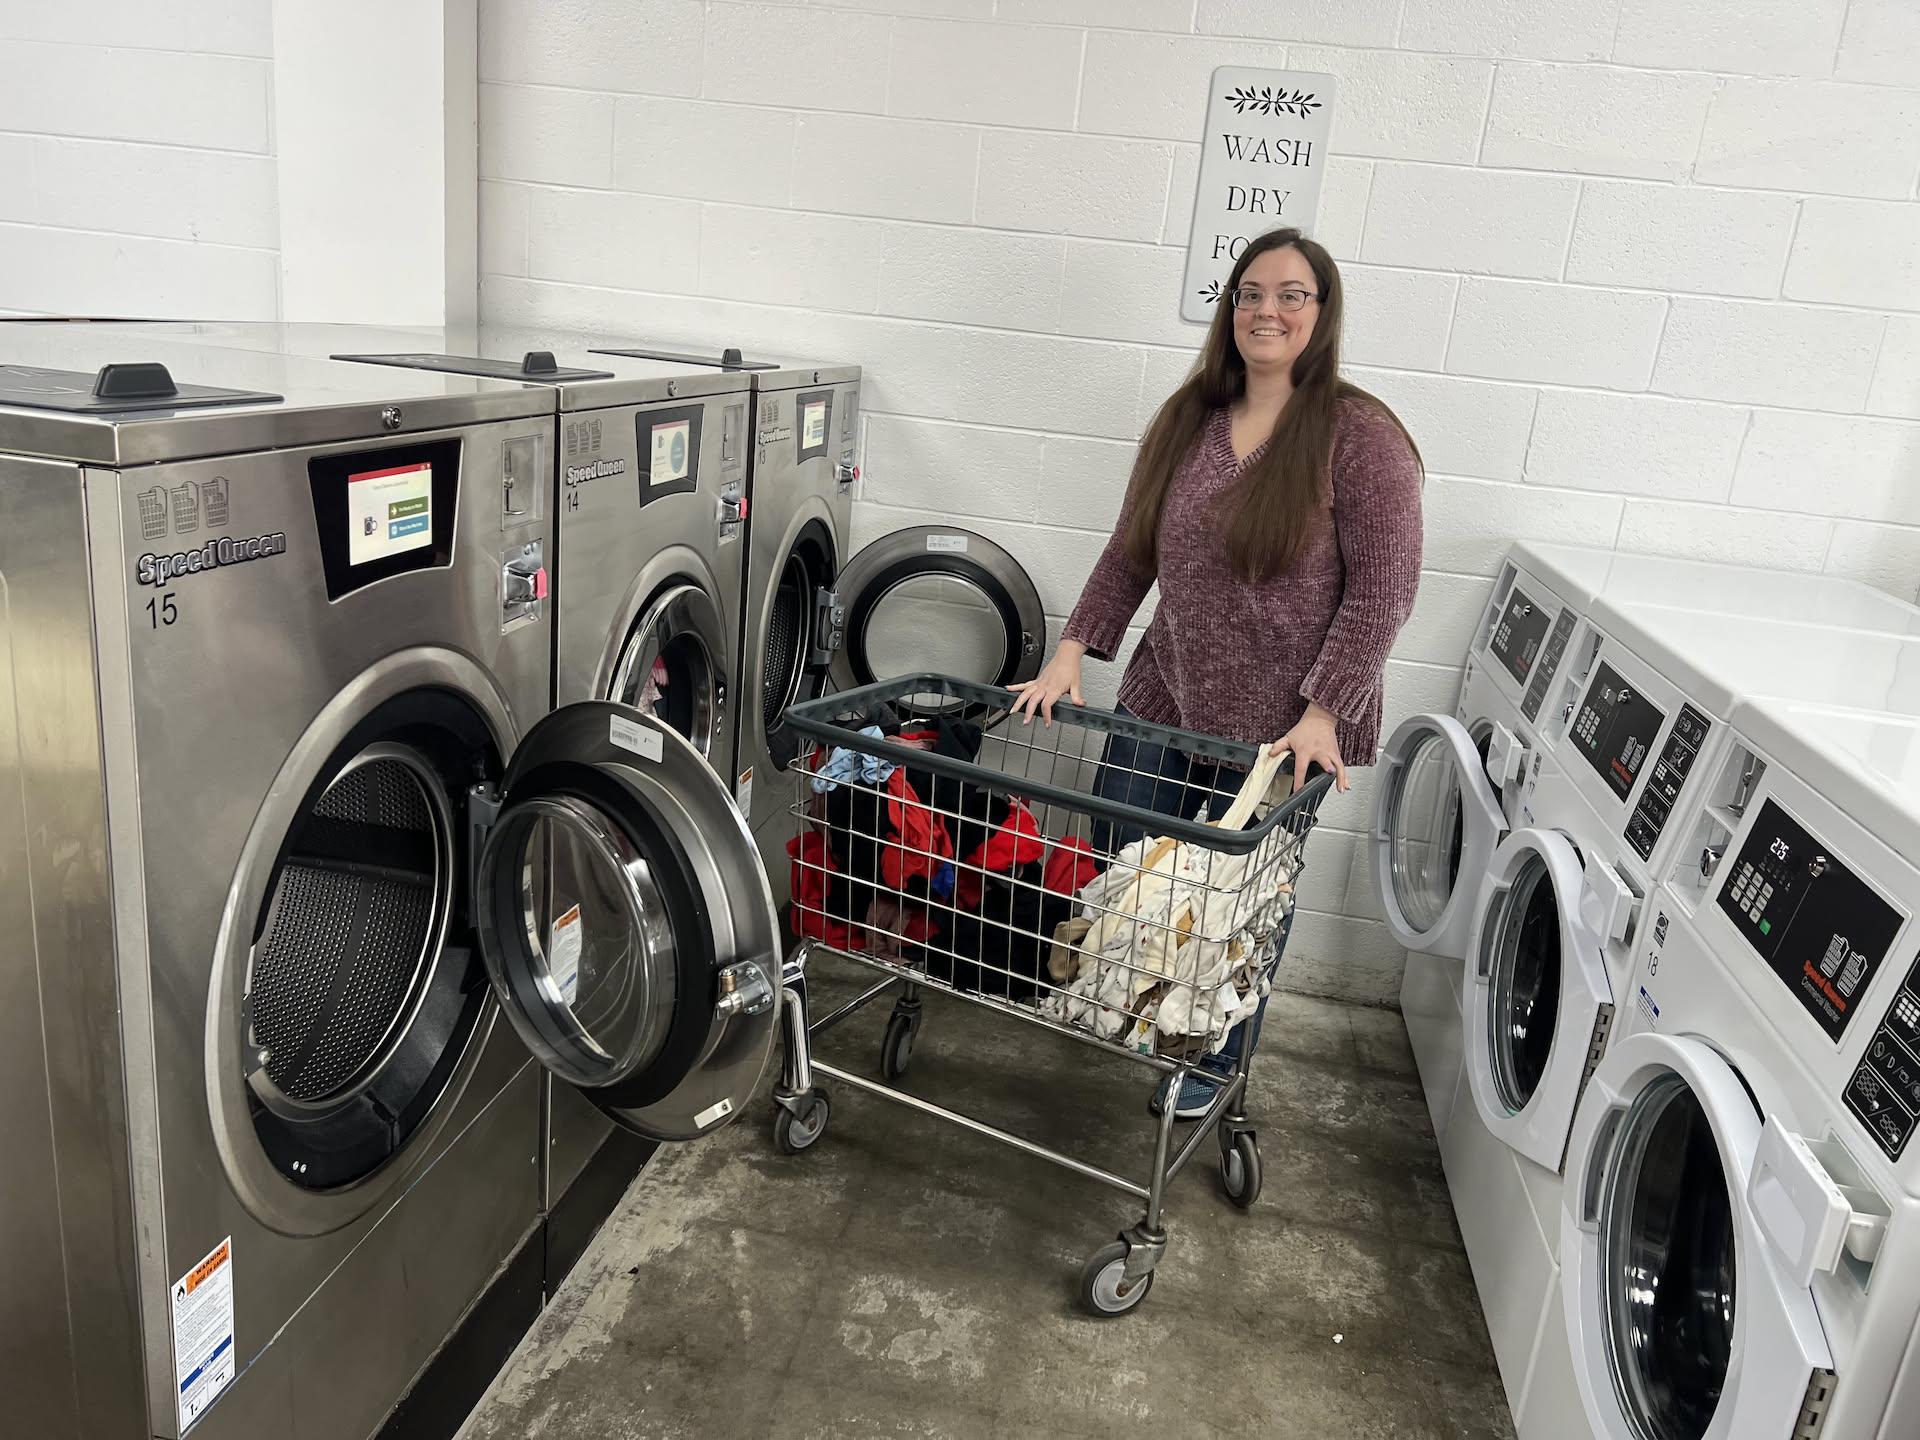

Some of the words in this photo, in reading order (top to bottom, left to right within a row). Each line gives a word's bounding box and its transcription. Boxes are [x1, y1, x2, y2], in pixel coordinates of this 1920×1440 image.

[1223, 134, 1313, 167] WASH
[1226, 186, 1292, 216] DRY
[1211, 234, 1250, 262] FO
[566, 491, 579, 512] 14
[146, 592, 178, 629] 15
[1647, 952, 1659, 976] 18
[1801, 975, 1826, 1007] Commercial
[1823, 999, 1841, 1023] Washer
[1803, 959, 1827, 988] Speed
[1823, 981, 1847, 1012] Queen
[196, 1246, 226, 1275] WARNING
